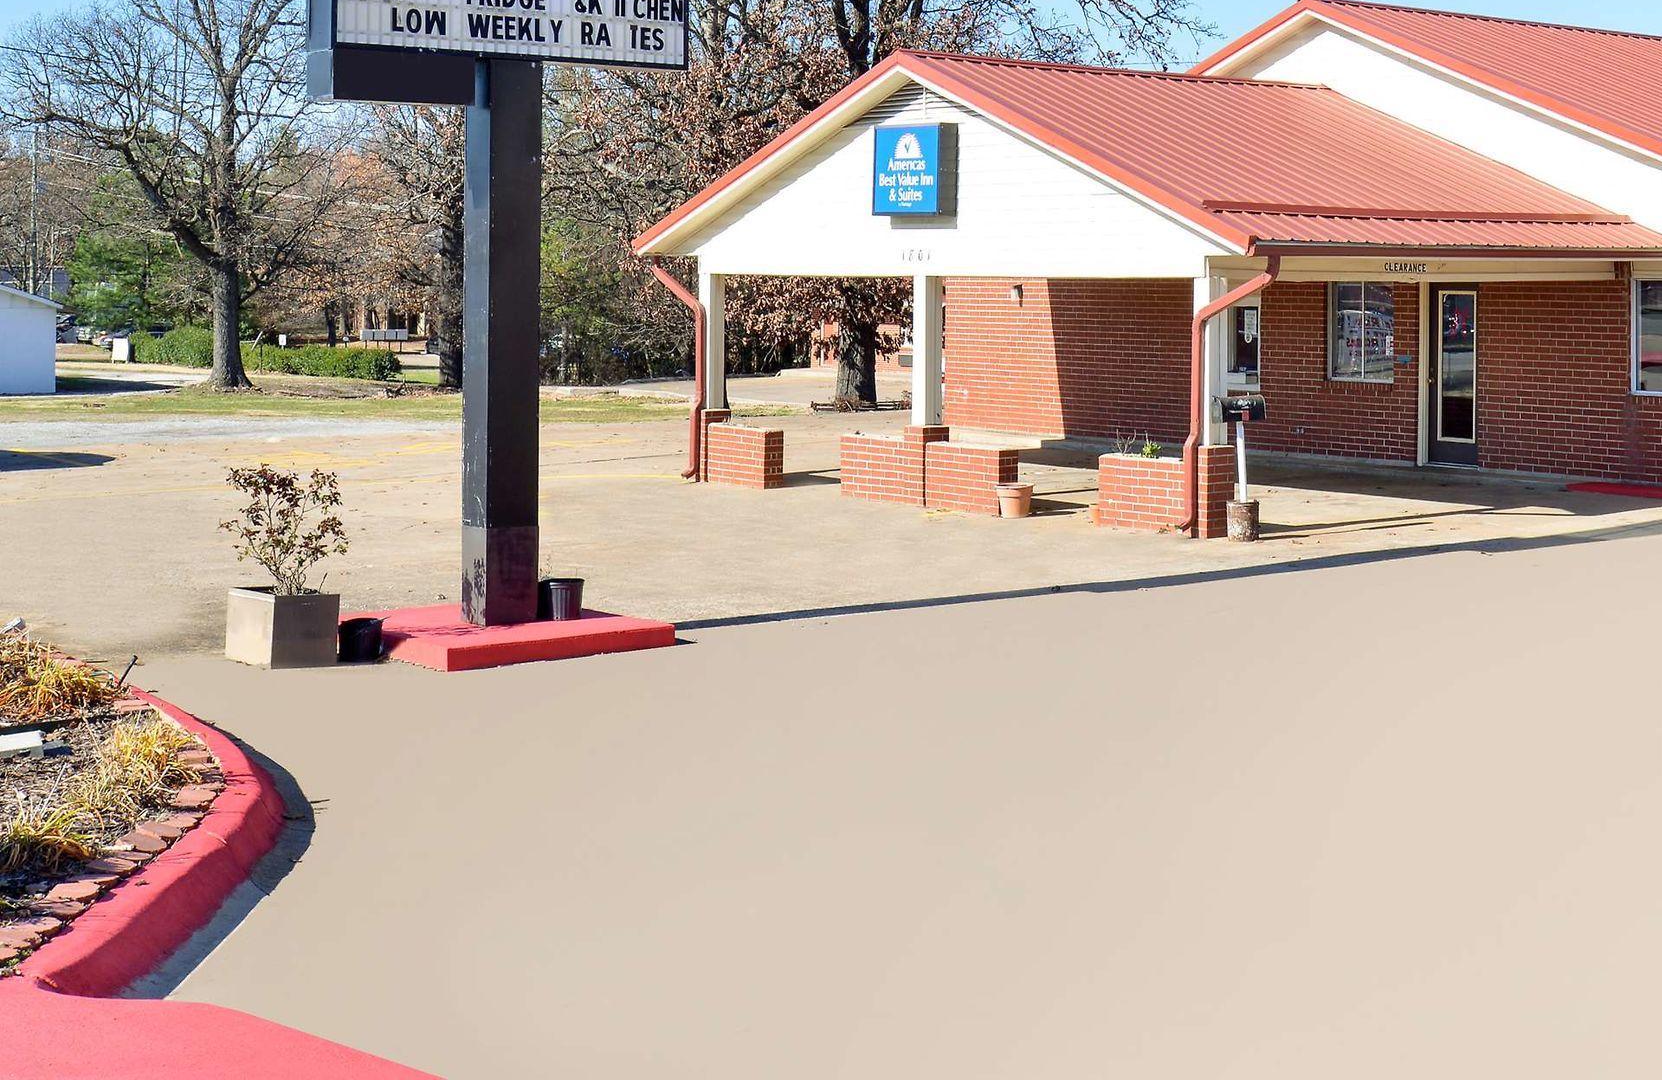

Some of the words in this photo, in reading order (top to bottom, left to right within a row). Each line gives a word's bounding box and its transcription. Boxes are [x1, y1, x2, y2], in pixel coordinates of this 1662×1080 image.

[392, 7, 447, 36] LOW
[467, 13, 563, 43] WEEKLY
[887, 158, 926, 171] Americas
[879, 173, 896, 187] Best
[897, 171, 919, 187] Value
[920, 172, 933, 186] Inn
[889, 187, 897, 201] &
[898, 187, 922, 201] Suites
[1384, 262, 1427, 273] CLEARANCE
